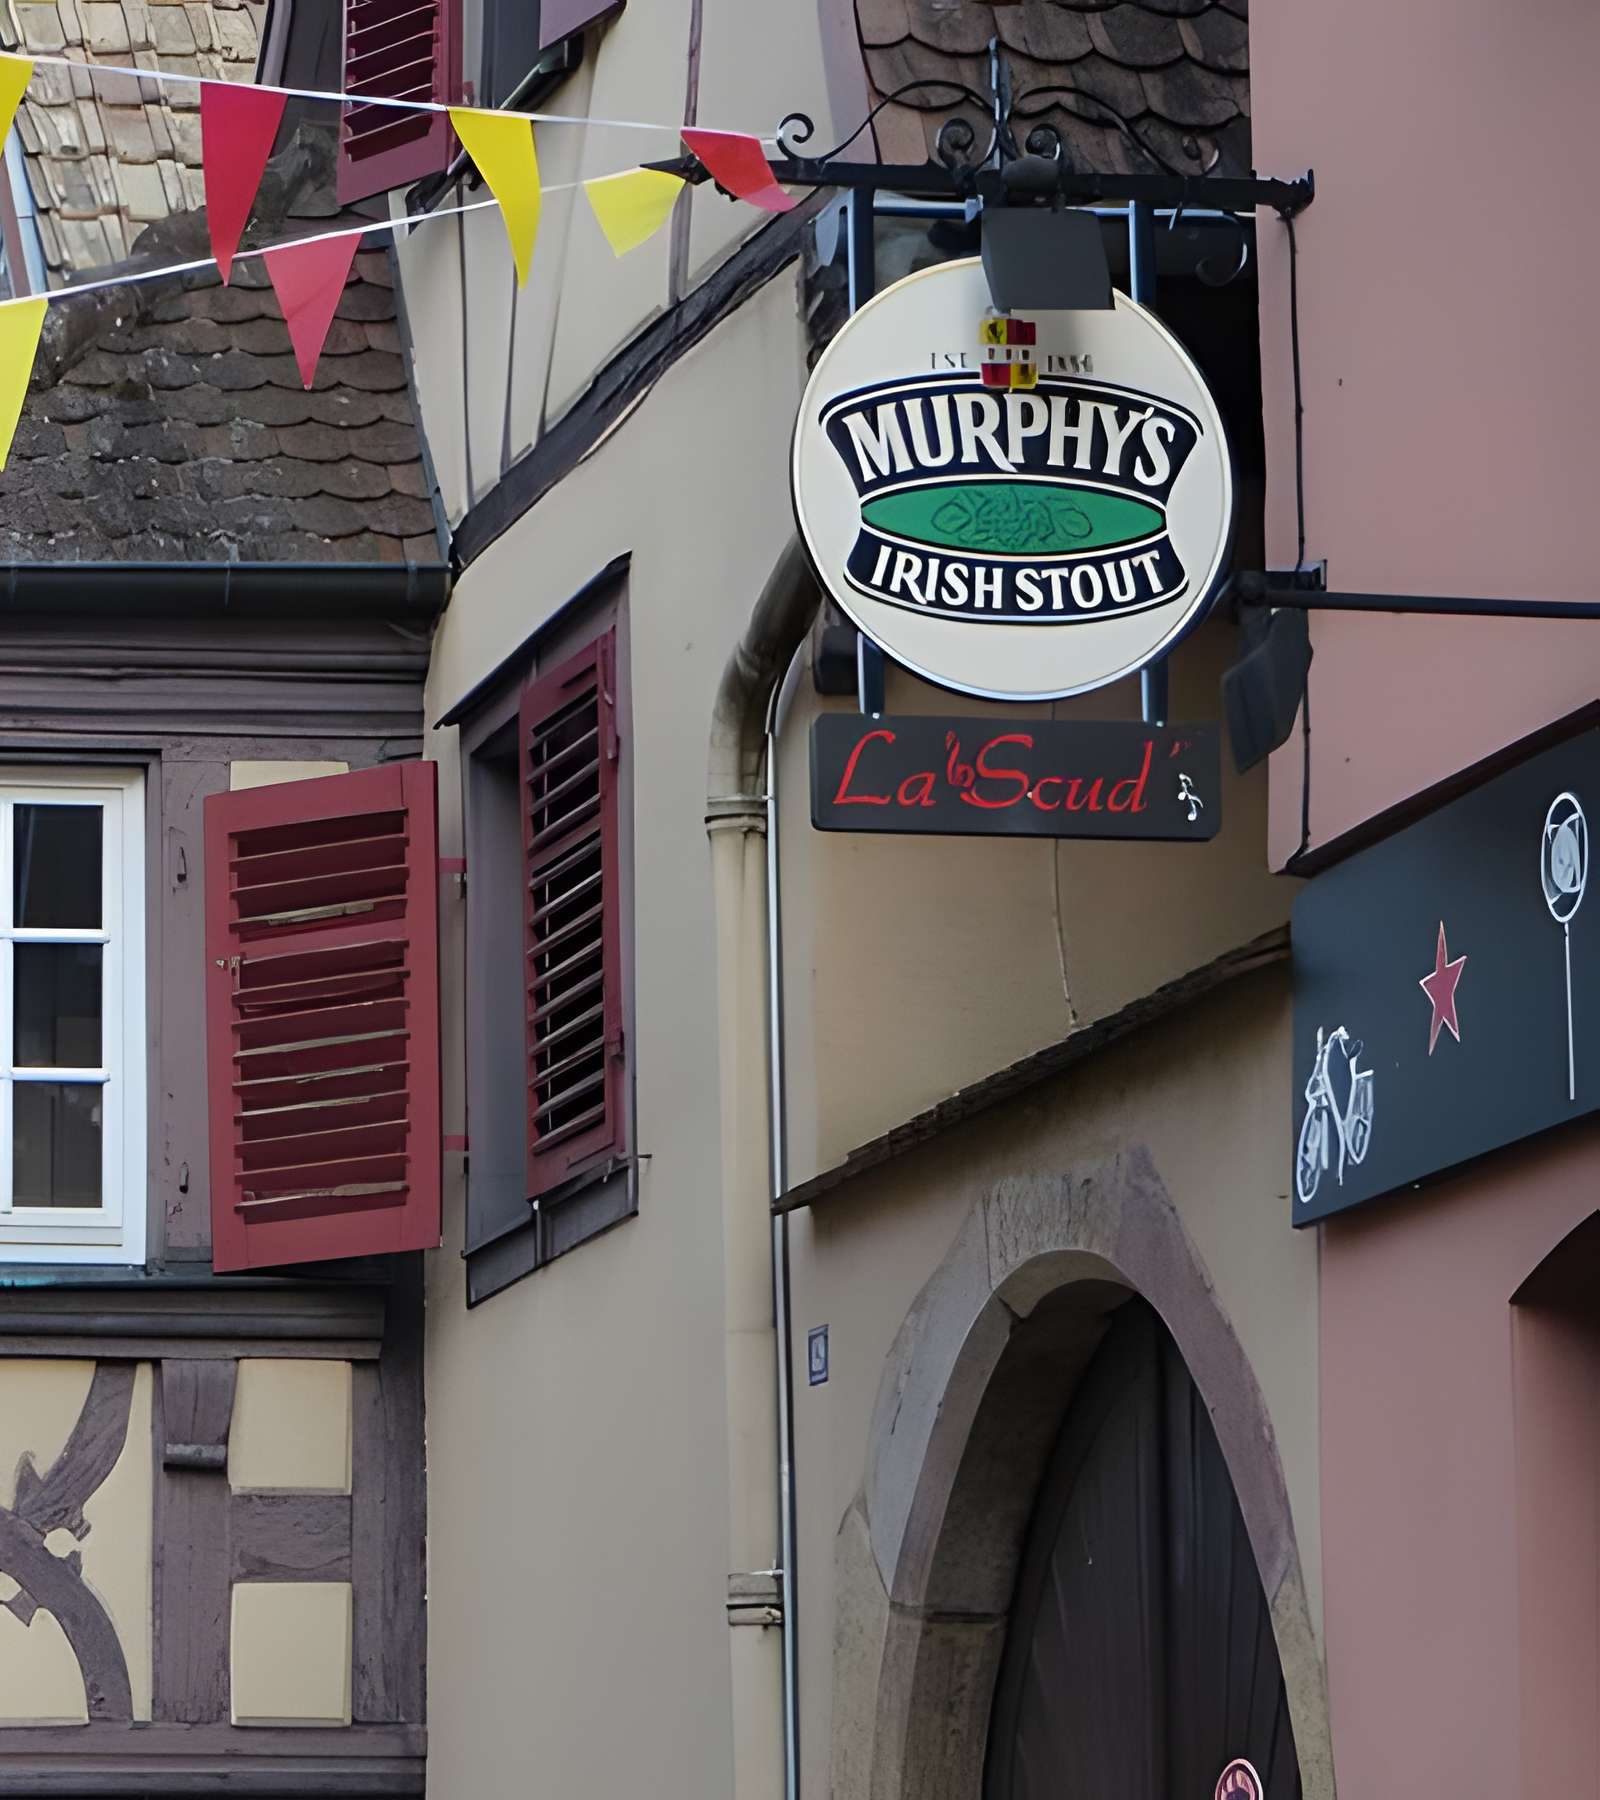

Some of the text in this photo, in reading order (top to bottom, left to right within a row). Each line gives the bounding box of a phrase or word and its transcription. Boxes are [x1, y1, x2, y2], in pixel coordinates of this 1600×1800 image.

[841, 391, 1176, 487] MURPHY'S
[871, 546, 1165, 612] IRISH STOUT
[832, 729, 937, 807] La
